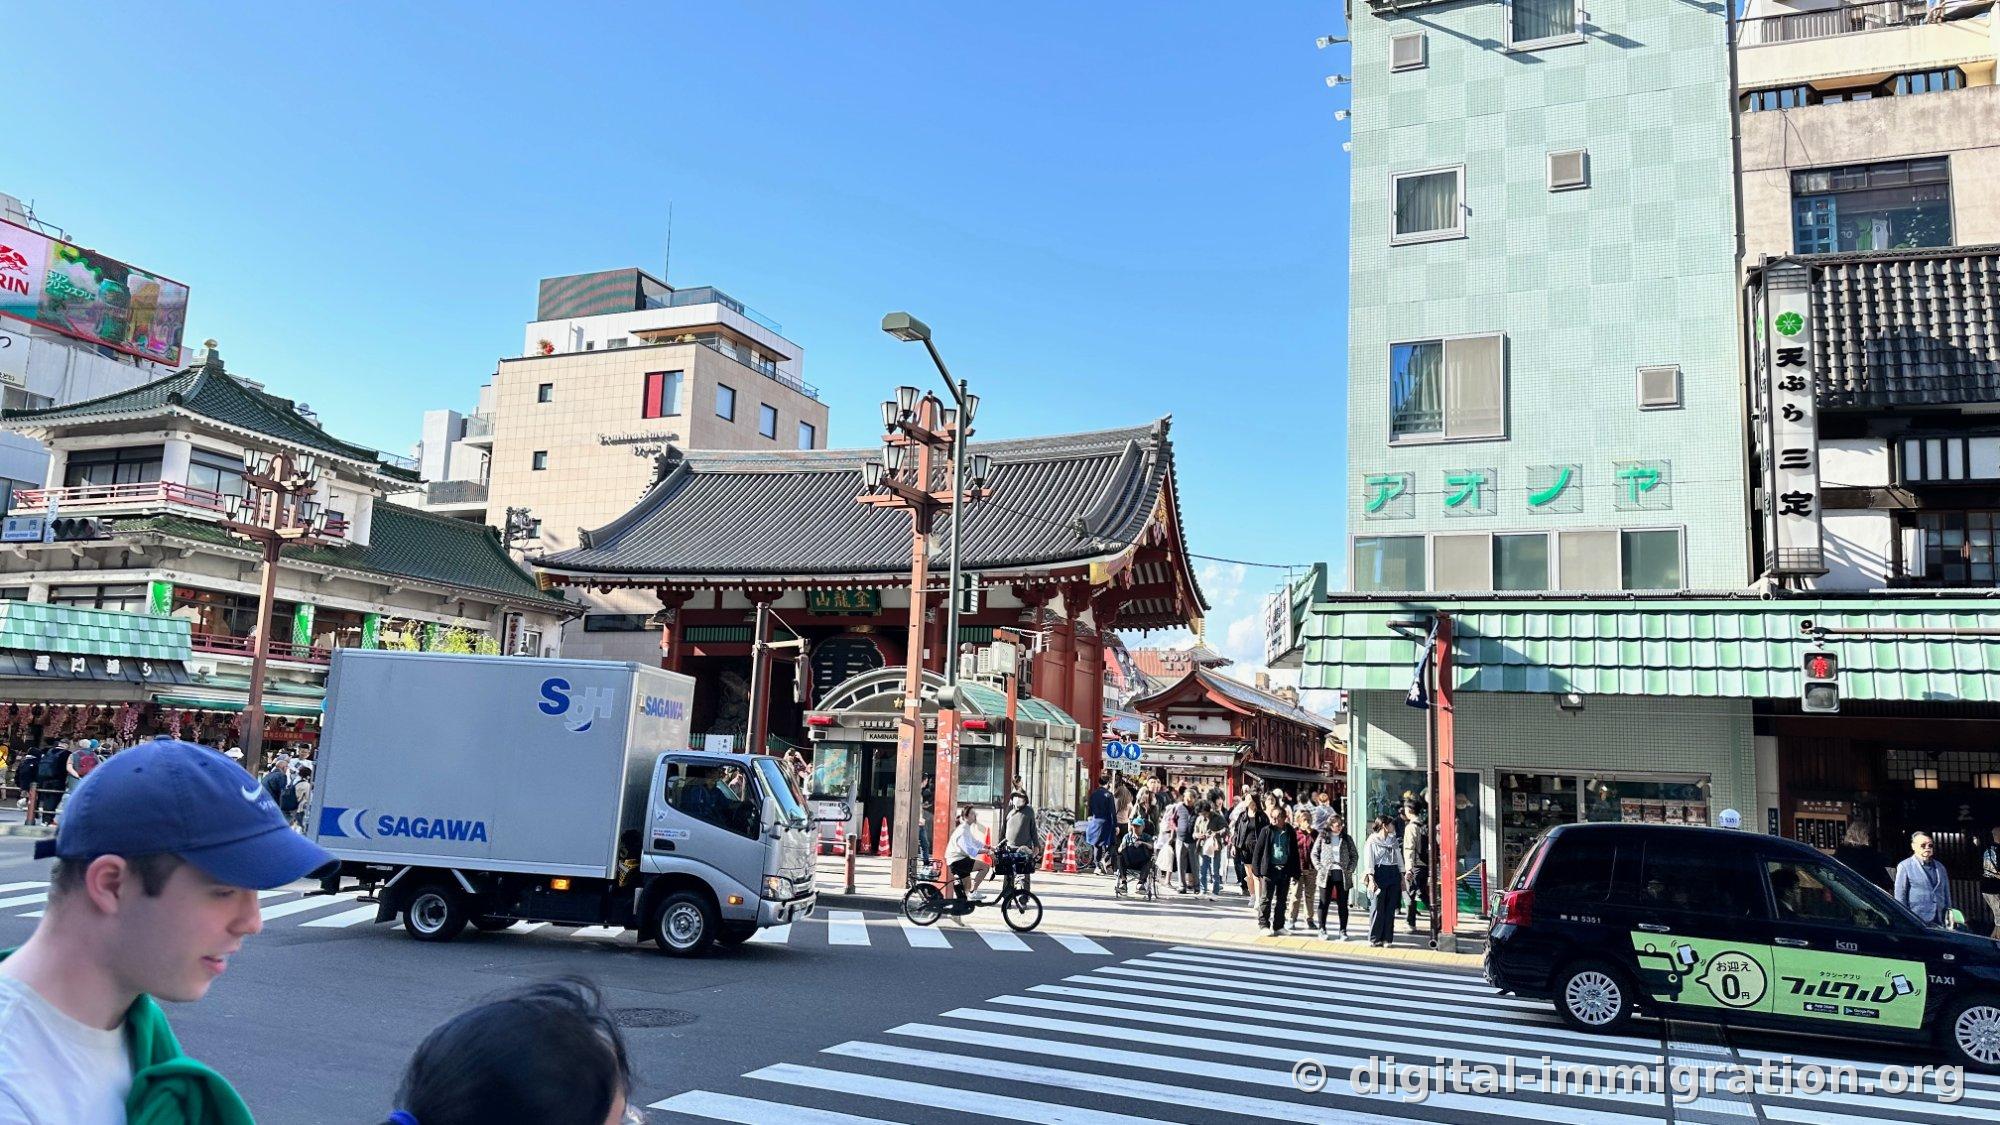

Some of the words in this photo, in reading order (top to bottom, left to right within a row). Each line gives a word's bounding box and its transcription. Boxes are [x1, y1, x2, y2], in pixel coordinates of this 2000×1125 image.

[1775, 345, 1814, 517] 天ぷら三定
[1364, 461, 1662, 513] アオノヤ
[645, 695, 683, 721] SAGAWA
[377, 815, 487, 842] SAGAWA
[1716, 961, 1752, 972] お迎え
[1819, 970, 1861, 980] タクシーアプリ
[1928, 974, 1955, 985] TAXI
